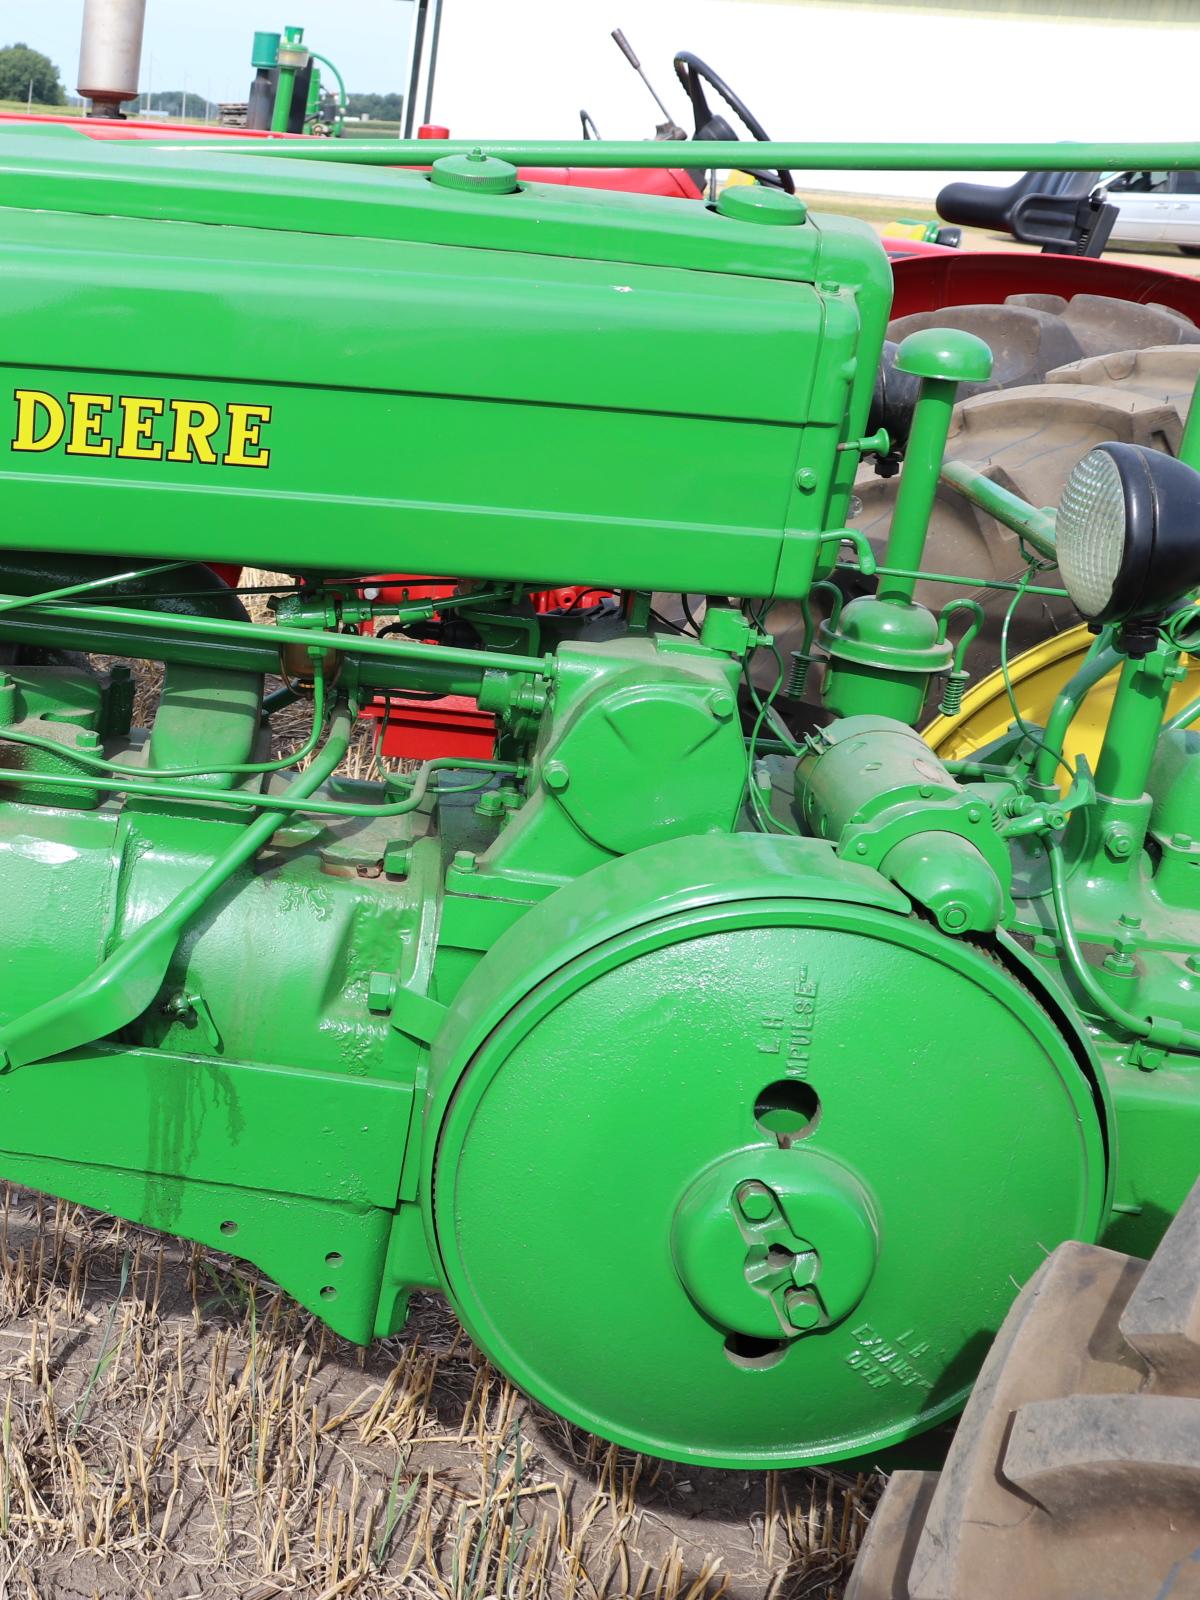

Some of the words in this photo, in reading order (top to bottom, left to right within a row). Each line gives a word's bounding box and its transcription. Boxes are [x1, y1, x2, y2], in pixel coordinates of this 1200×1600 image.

[11, 388, 273, 469] DEERE
[785, 981, 818, 1080] MPULSE
[846, 1350, 892, 1389] OPEN
[851, 1322, 923, 1387] EXHAUST
